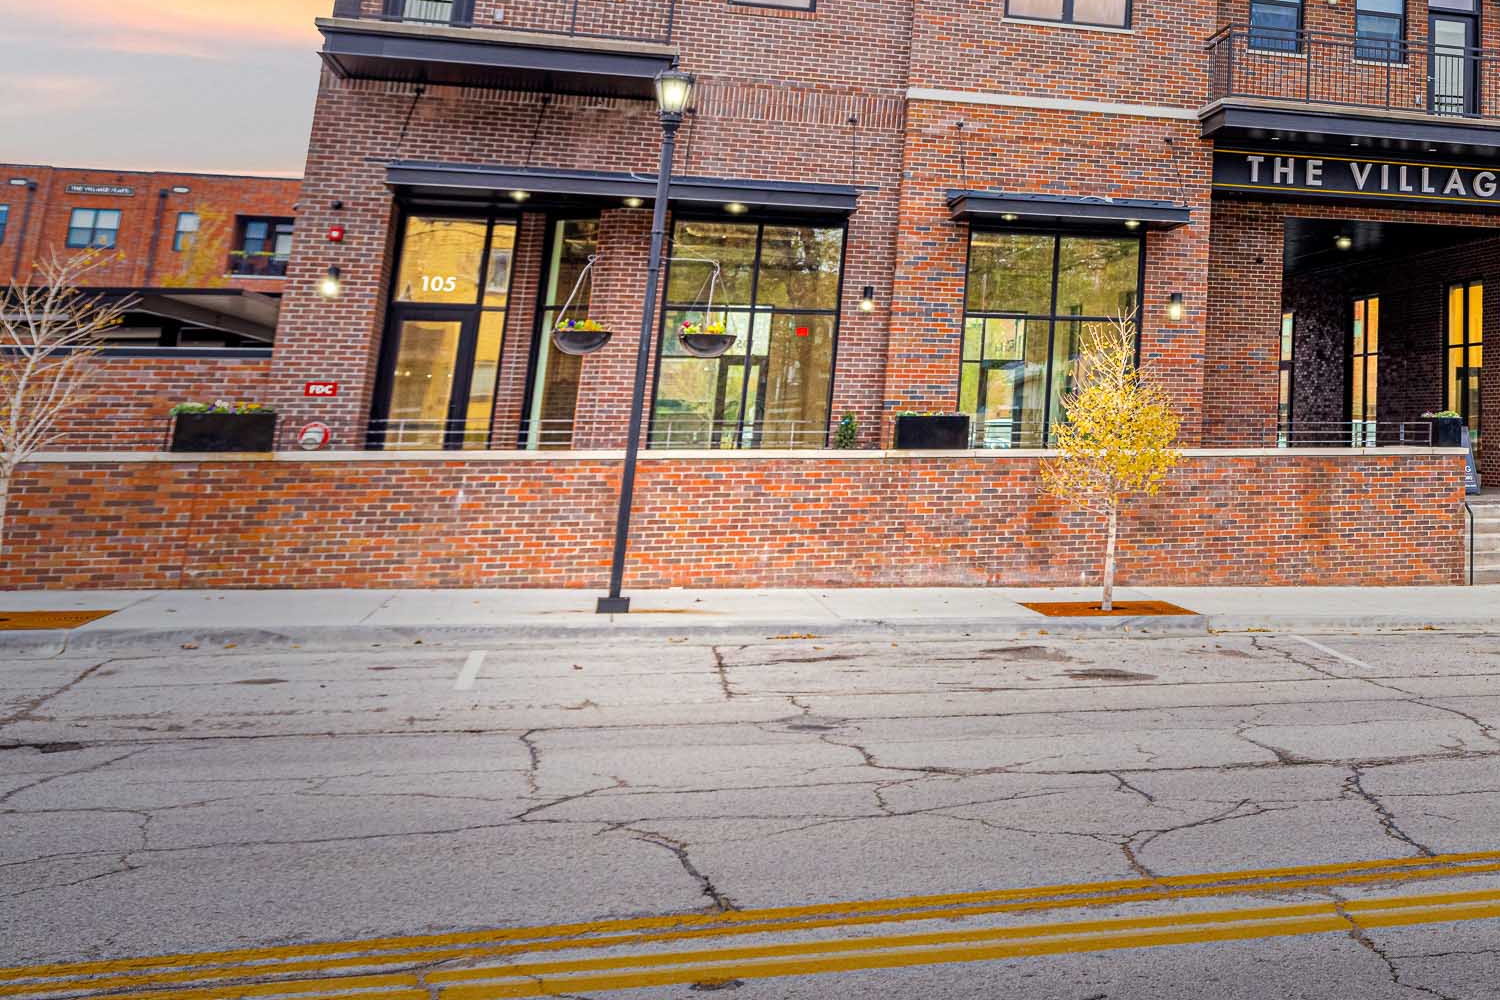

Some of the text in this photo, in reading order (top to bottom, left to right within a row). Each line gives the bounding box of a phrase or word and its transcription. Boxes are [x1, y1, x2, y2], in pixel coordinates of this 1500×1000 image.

[1247, 155, 1323, 187] THE
[421, 274, 457, 292] 105
[309, 384, 333, 395] FDC
